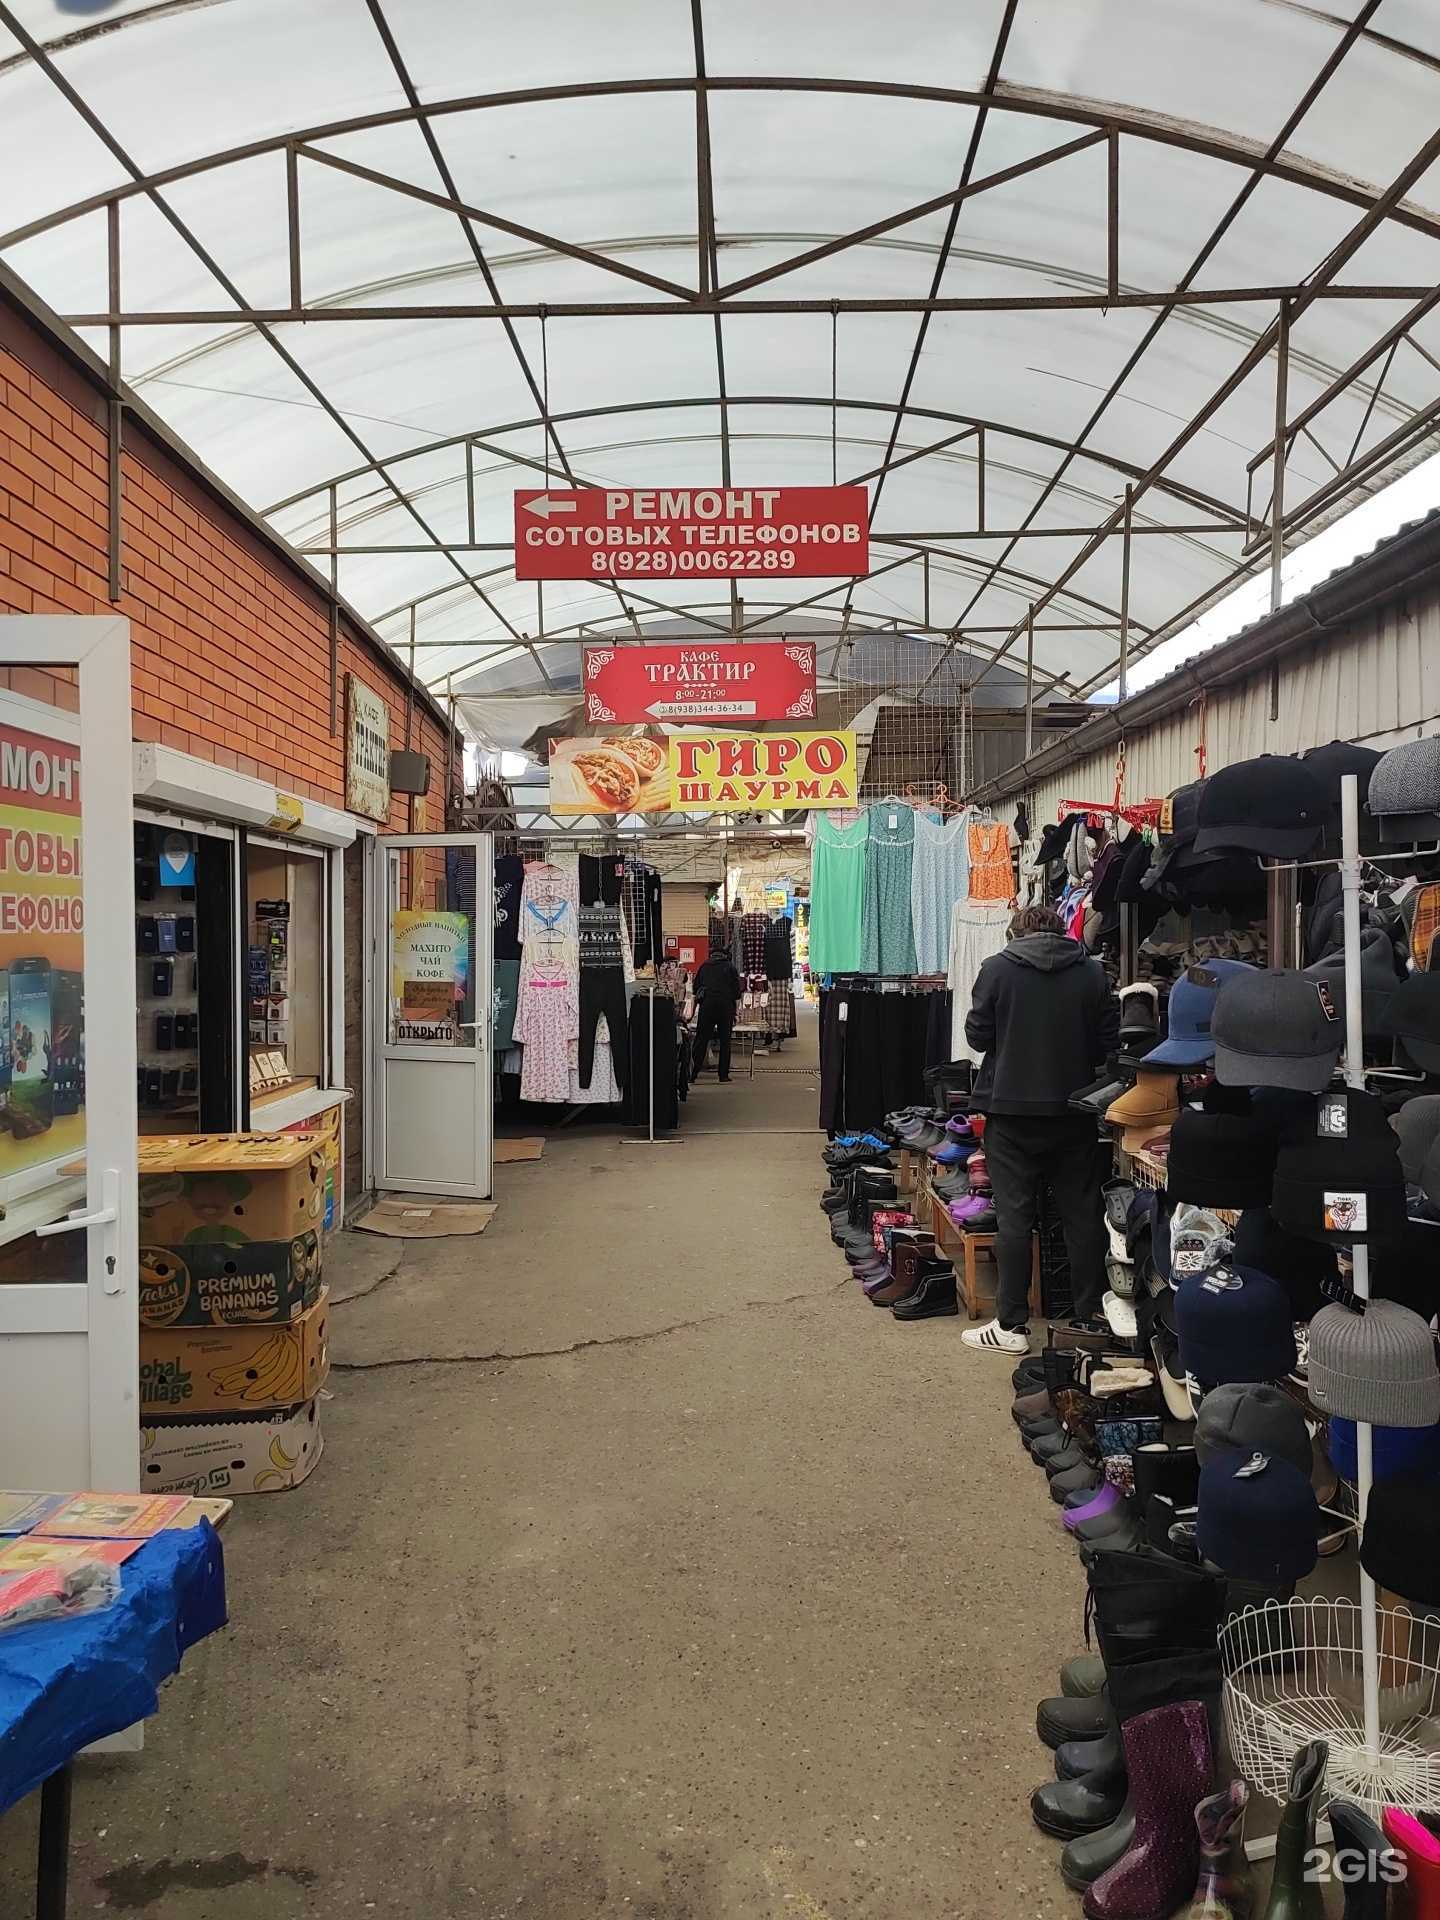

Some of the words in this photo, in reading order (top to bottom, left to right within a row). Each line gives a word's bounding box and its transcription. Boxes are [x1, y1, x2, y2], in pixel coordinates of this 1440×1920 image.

[606, 490, 781, 520] РЕМОНТ
[525, 526, 672, 547] СОТОВЫХ
[680, 523, 861, 545] ТЕЛЕФОНОВ
[591, 549, 796, 575] 8(928)0062289
[679, 650, 720, 663] КАФЕ
[643, 661, 757, 683] ТРАКТИР
[675, 737, 848, 779] ГИРО
[678, 779, 851, 802] ШАУРМА
[0, 828, 83, 876] ТОВЫ
[410, 943, 452, 953] МАХИТО
[420, 954, 442, 966] ЧАЙ
[416, 969, 445, 978] КОФЕ
[398, 1024, 453, 1041] ОТКРЫТО
[197, 1272, 277, 1295] PREMIUM
[142, 1296, 185, 1315] ANANAS
[200, 1290, 280, 1312] BANANAS
